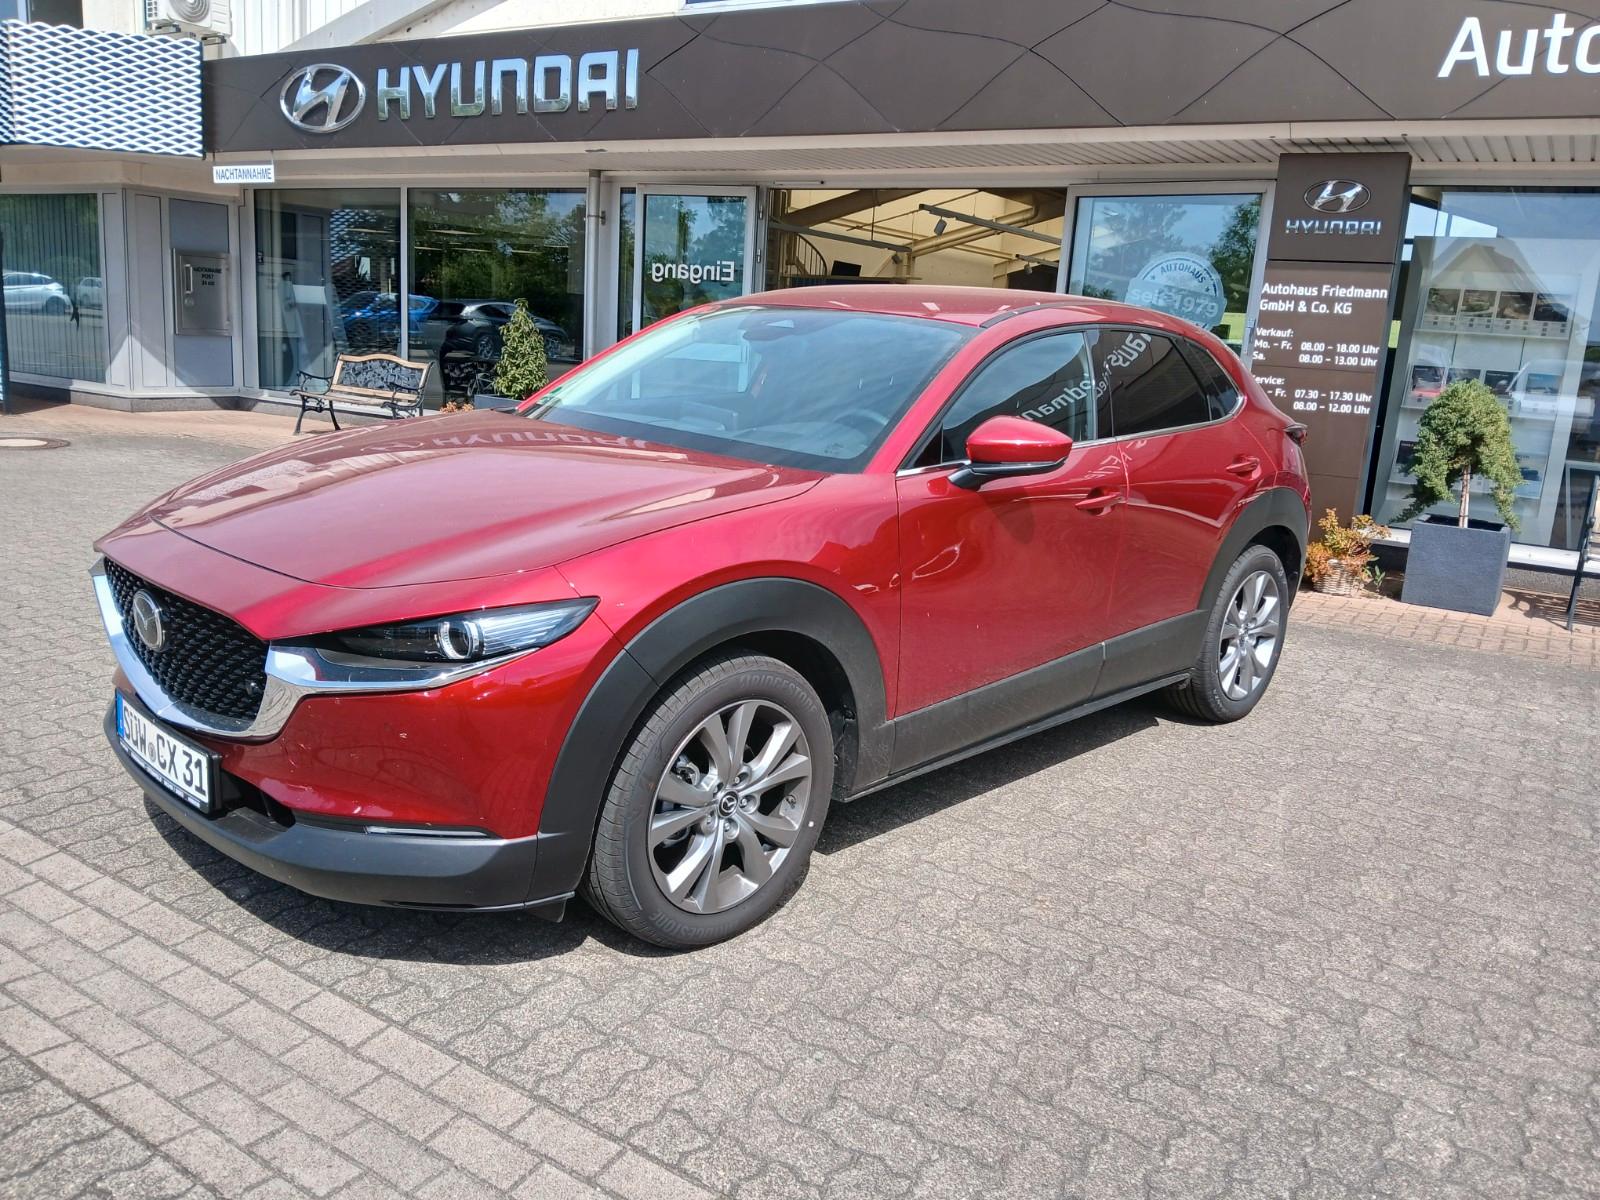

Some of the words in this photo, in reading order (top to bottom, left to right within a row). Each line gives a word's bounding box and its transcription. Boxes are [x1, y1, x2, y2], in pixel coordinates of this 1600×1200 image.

[377, 48, 639, 121] HYUNDAI
[215, 167, 272, 181] NACHTANNAHME
[1285, 219, 1382, 236] HYUNDAI
[1160, 262, 1207, 284] AUTOHAUS
[1261, 282, 1319, 297] Autohaus
[1321, 284, 1388, 299] Friedmann
[1175, 293, 1219, 318] 1979
[1259, 299, 1295, 312] GmbH
[1297, 300, 1308, 313] &
[1311, 301, 1330, 313] Co.
[1333, 302, 1353, 315] KG
[1256, 327, 1294, 338] Verkauf:
[1254, 339, 1271, 349] Mo.
[1280, 340, 1293, 350] Fr.
[1300, 341, 1326, 352] 08.00
[1336, 343, 1361, 354] 18.00
[1361, 344, 1381, 355] Uhr
[1252, 351, 1266, 361] Sa.
[1298, 353, 1324, 364] 08.00
[1334, 355, 1359, 366] 13.00
[1360, 356, 1379, 367] Uhr
[1253, 374, 1286, 385] ervice:
[1274, 388, 1288, 398] Fr.
[1294, 389, 1319, 400] 07.30
[1329, 391, 1354, 402] 17.30
[1354, 392, 1373, 403] Uhr
[1293, 401, 1318, 412] 08.00
[1328, 403, 1353, 414] 12.00
[1353, 404, 1371, 415] Uhr
[156, 733, 179, 781] CX
[182, 749, 207, 797] 31
